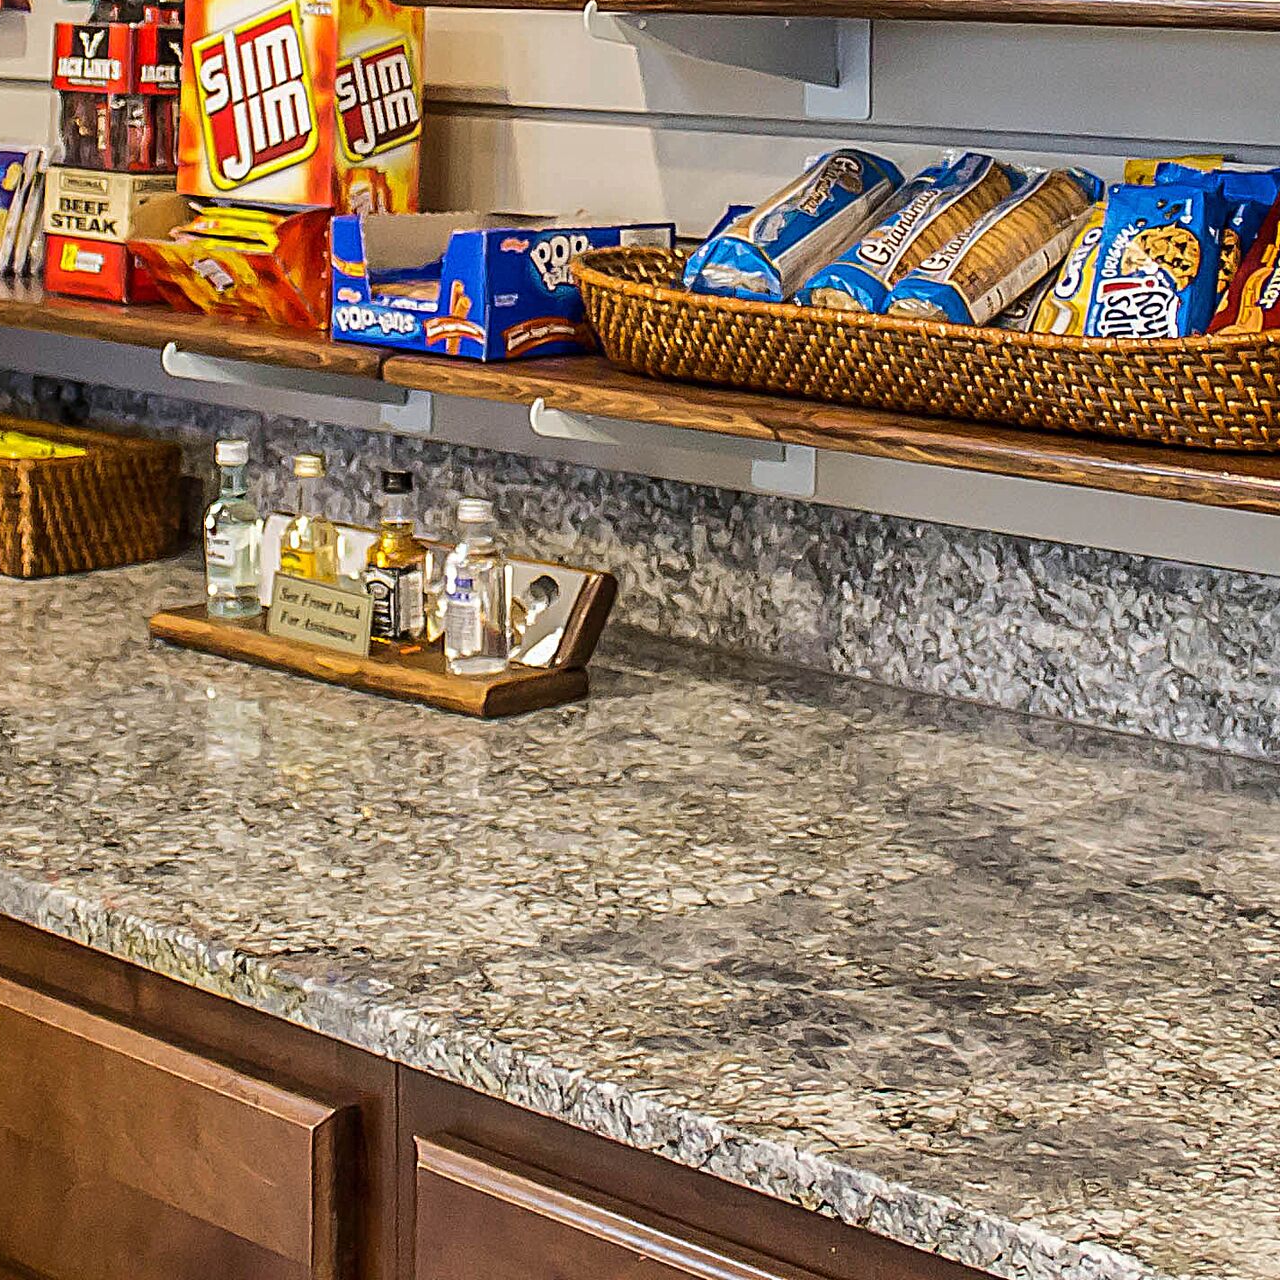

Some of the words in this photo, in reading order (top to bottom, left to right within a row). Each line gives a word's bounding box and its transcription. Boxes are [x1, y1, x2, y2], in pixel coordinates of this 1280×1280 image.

[58, 197, 110, 216] BEEF
[49, 213, 118, 235] STEAK
[1100, 224, 1140, 277] ORIGINAL
